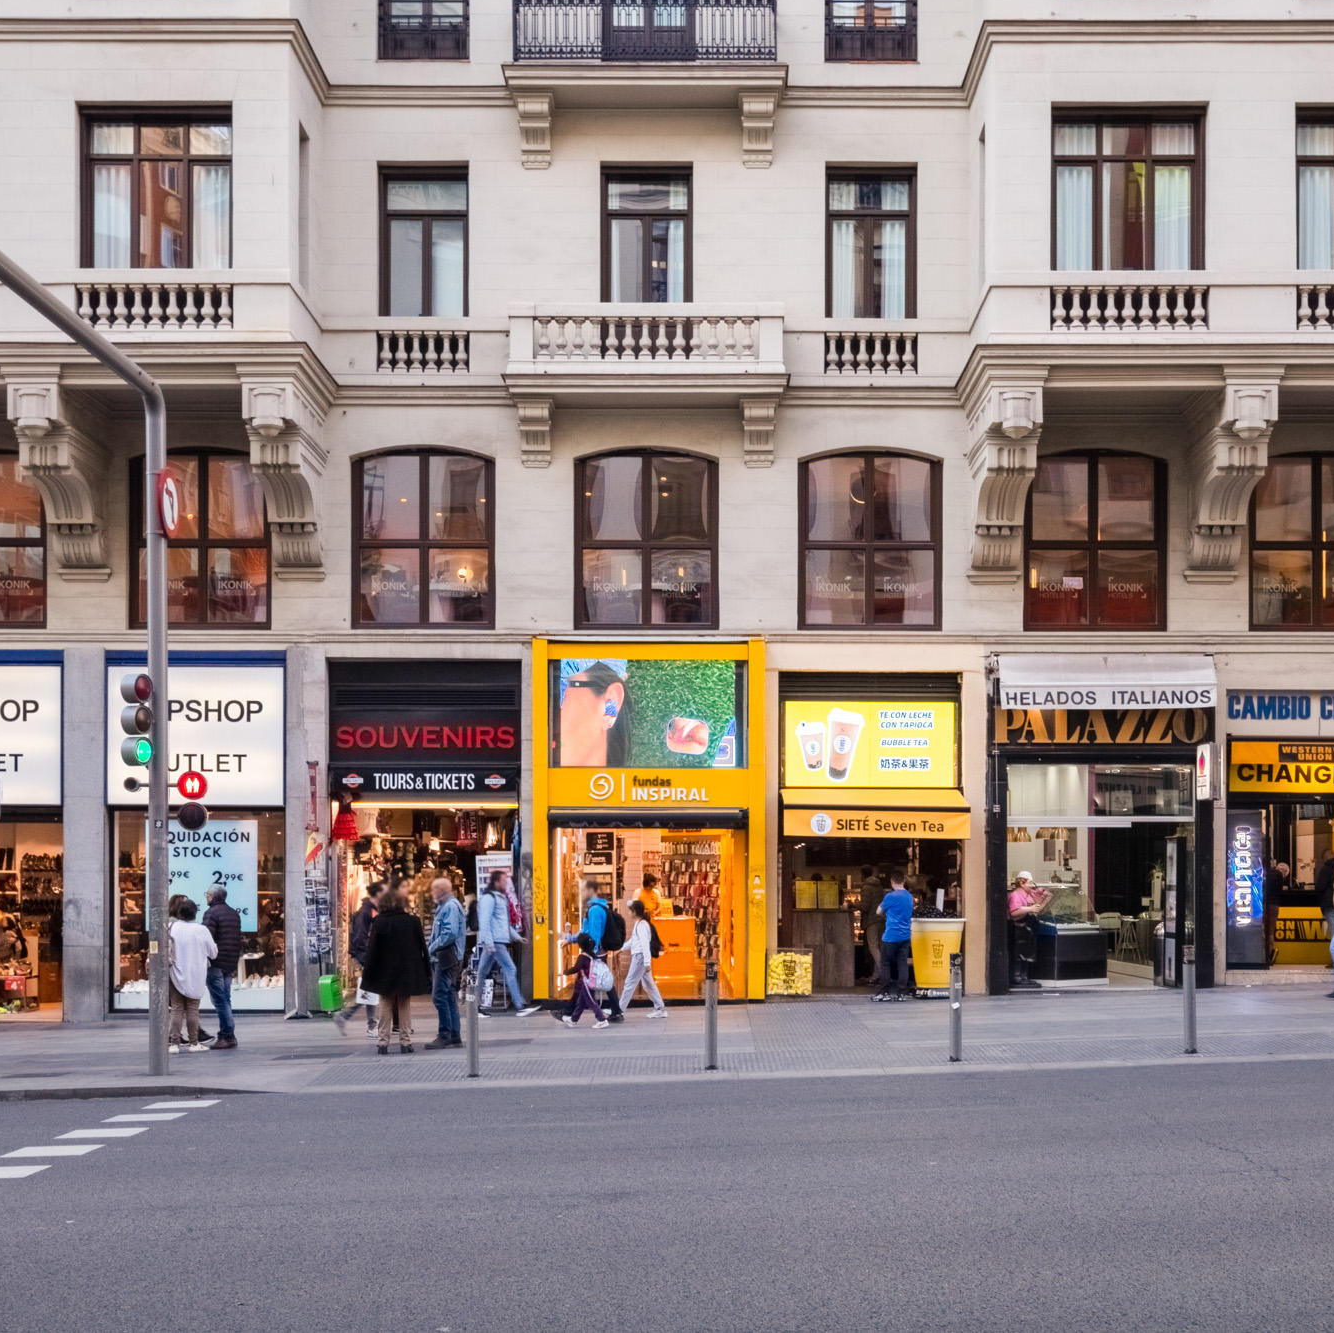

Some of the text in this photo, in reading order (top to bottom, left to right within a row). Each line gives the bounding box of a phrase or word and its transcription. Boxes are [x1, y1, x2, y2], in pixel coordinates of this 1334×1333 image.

[168, 580, 185, 589] NIK
[218, 580, 254, 589] IKONIK
[816, 583, 851, 592] IKONIK
[1108, 583, 1144, 592] IKONIK
[1263, 584, 1299, 593] IKONIK
[1005, 689, 1212, 705] HELADOS ITALIANOS
[168, 699, 263, 723] PSHOP
[1227, 694, 1311, 720] CAMBIO
[890, 711, 906, 719] CON
[908, 711, 933, 719] LECHE
[880, 721, 934, 729] CON TAPIOCA
[993, 708, 1208, 744] PALAZZO
[336, 726, 515, 749] SOUVENIRS
[1281, 746, 1332, 754] WESTERN
[168, 754, 248, 772] UTLET
[1298, 754, 1332, 762] UNION
[633, 775, 672, 787] fundas
[631, 787, 709, 801] INSPIRAL
[836, 816, 944, 832] SIETÉ Seven Tea
[167, 829, 250, 844] QUIDACIÓN
[173, 846, 223, 858] STOCK
